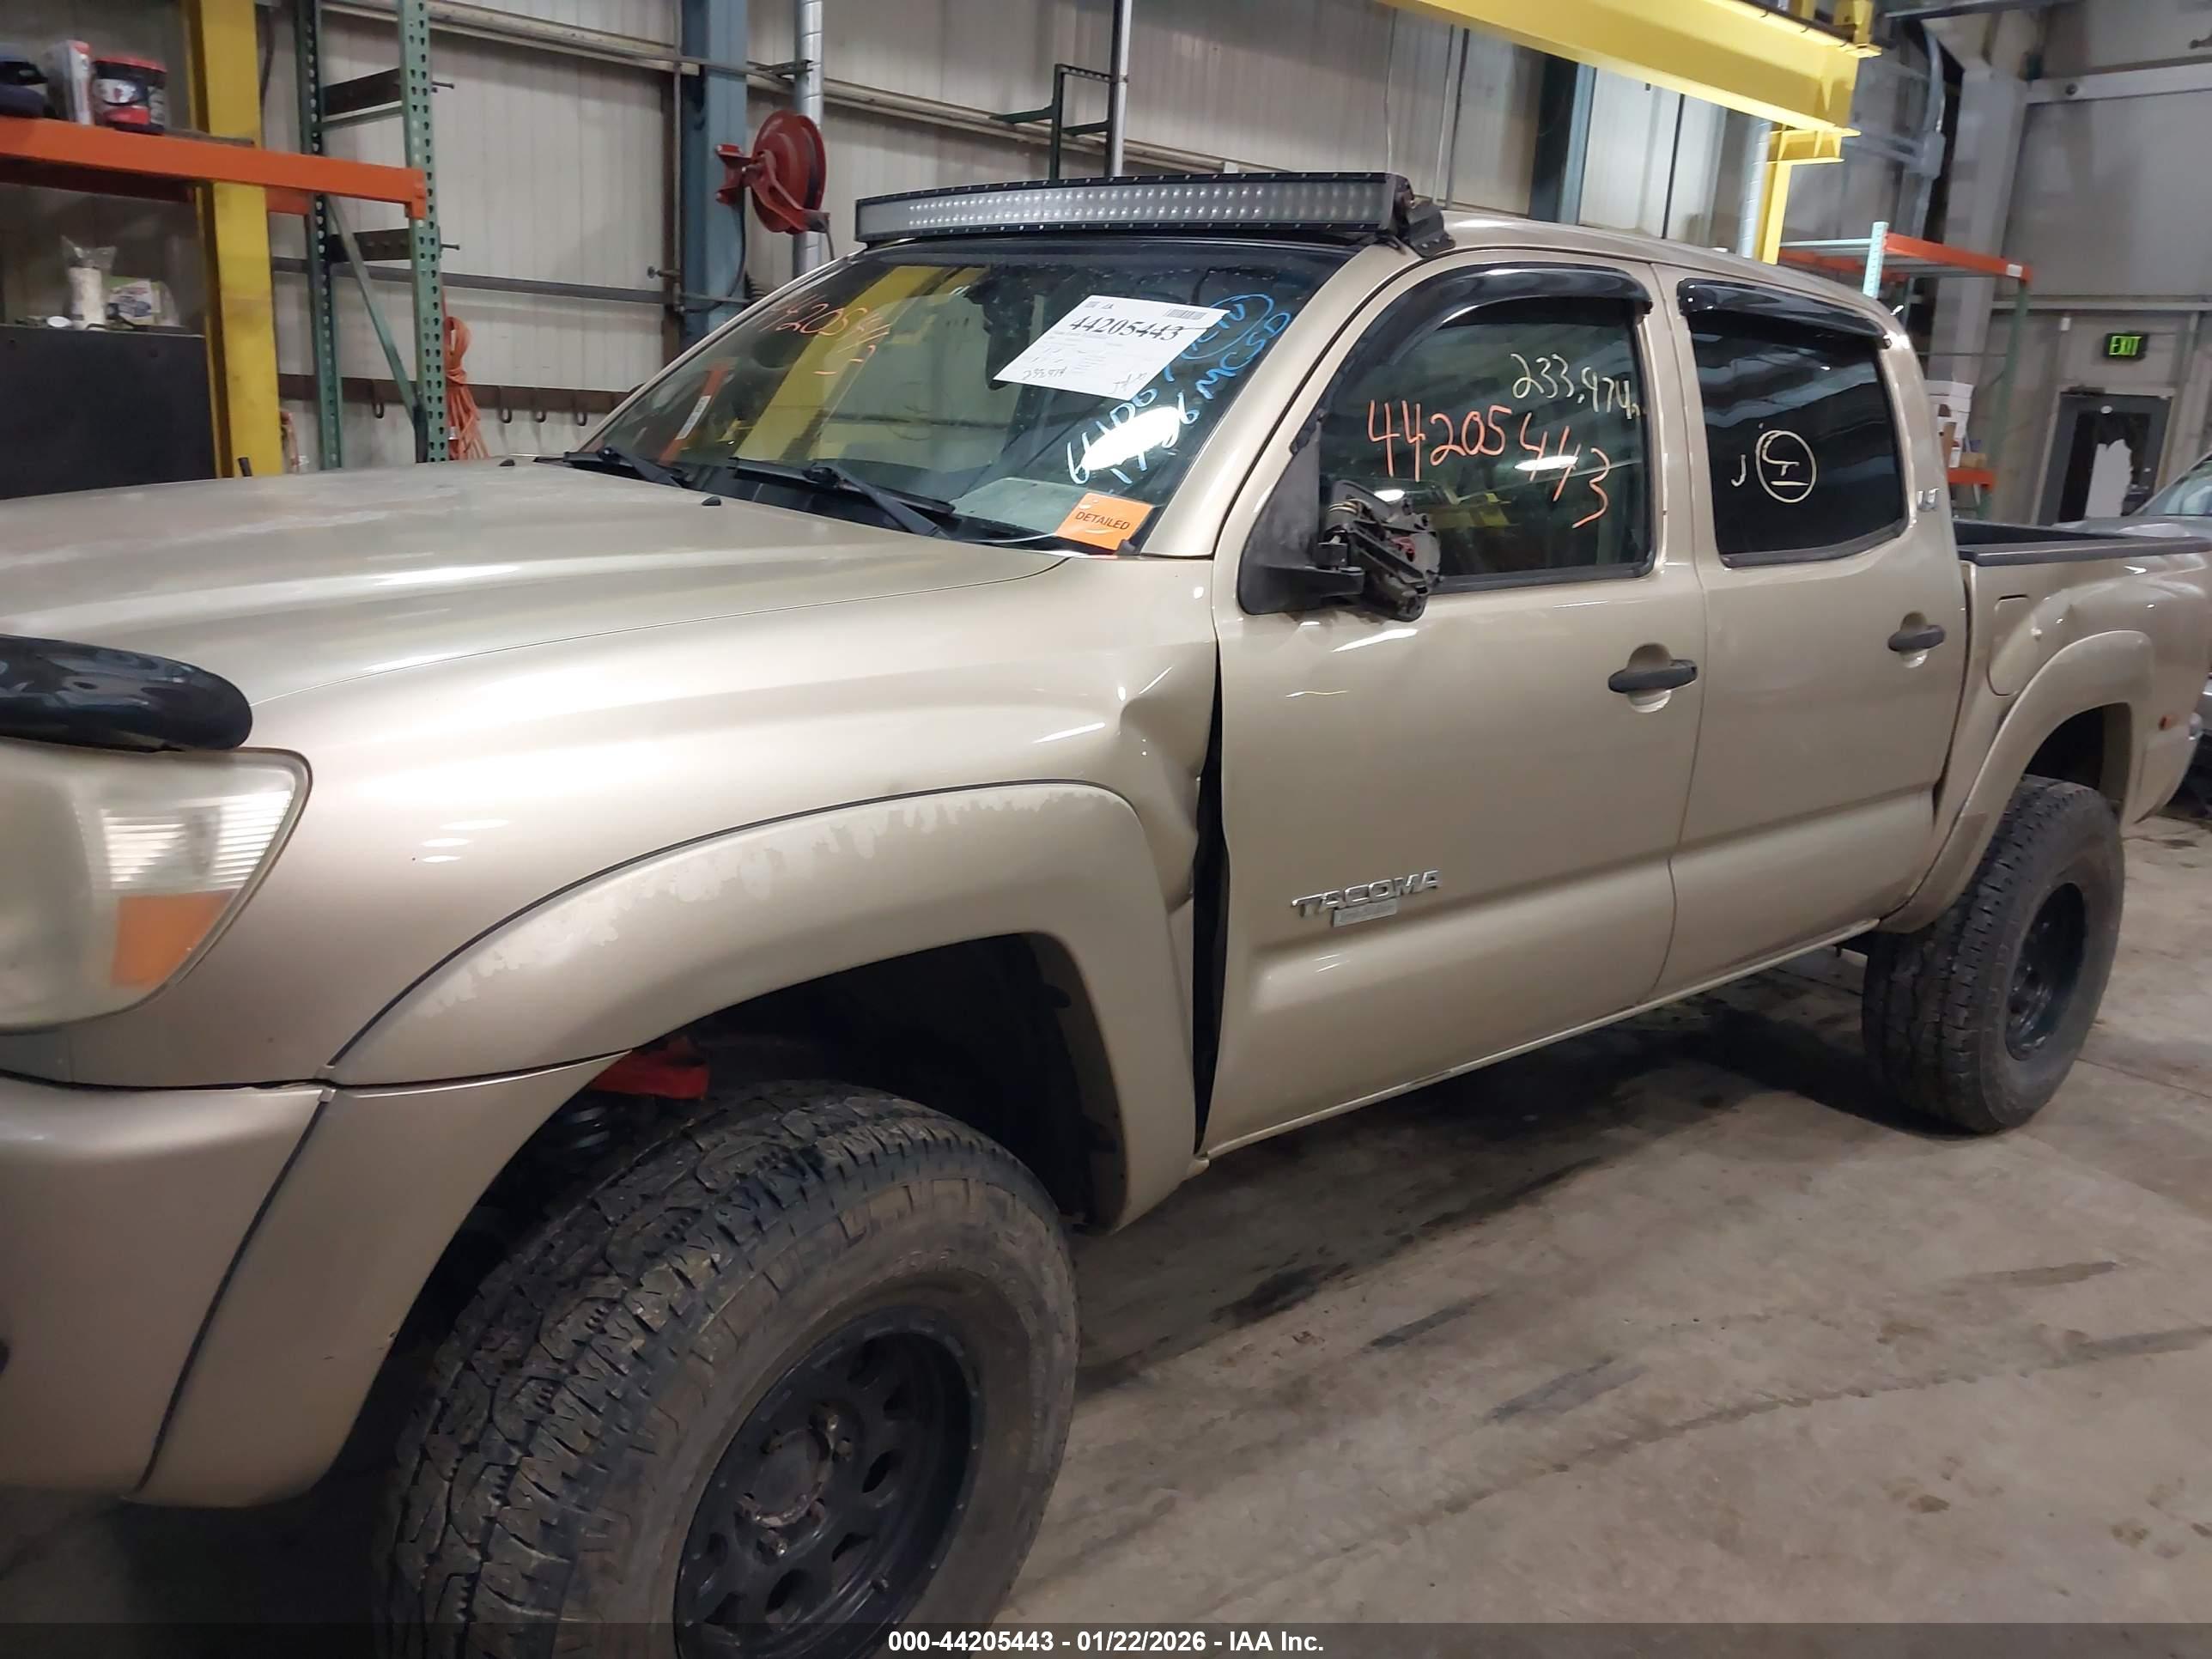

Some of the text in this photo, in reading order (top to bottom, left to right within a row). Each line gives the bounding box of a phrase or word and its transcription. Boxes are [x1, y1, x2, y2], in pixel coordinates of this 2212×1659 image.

[1069, 314, 1185, 341] 44205443
[2108, 335, 2143, 356] EXIT
[1075, 511, 1132, 531] DETAILED
[1291, 870, 1444, 917] TACOMA
